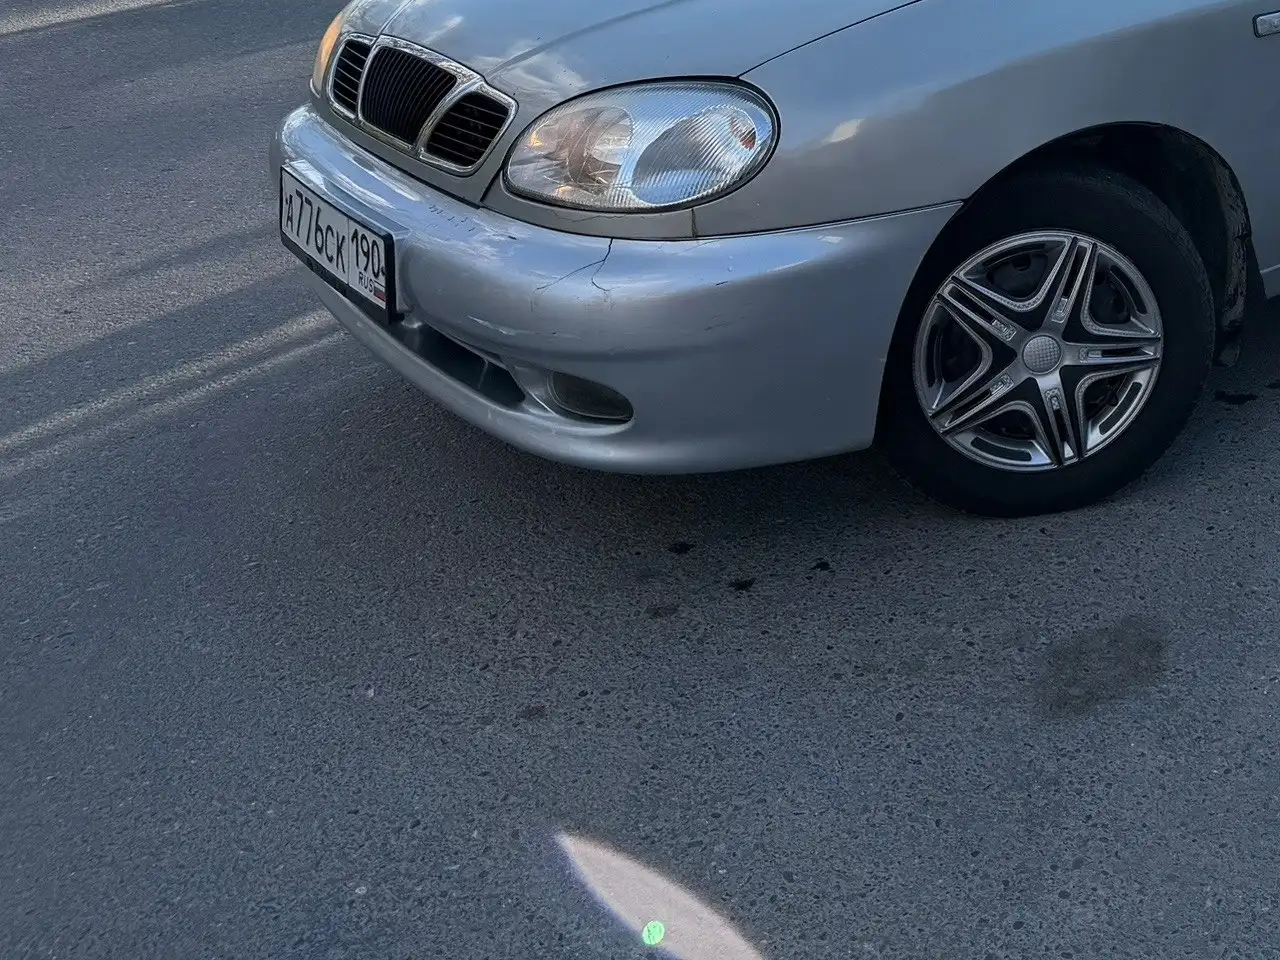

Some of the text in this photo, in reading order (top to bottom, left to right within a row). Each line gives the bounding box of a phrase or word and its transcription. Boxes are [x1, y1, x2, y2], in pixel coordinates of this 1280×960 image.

[285, 188, 381, 280] А776СК 190
[358, 271, 375, 293] RUS
